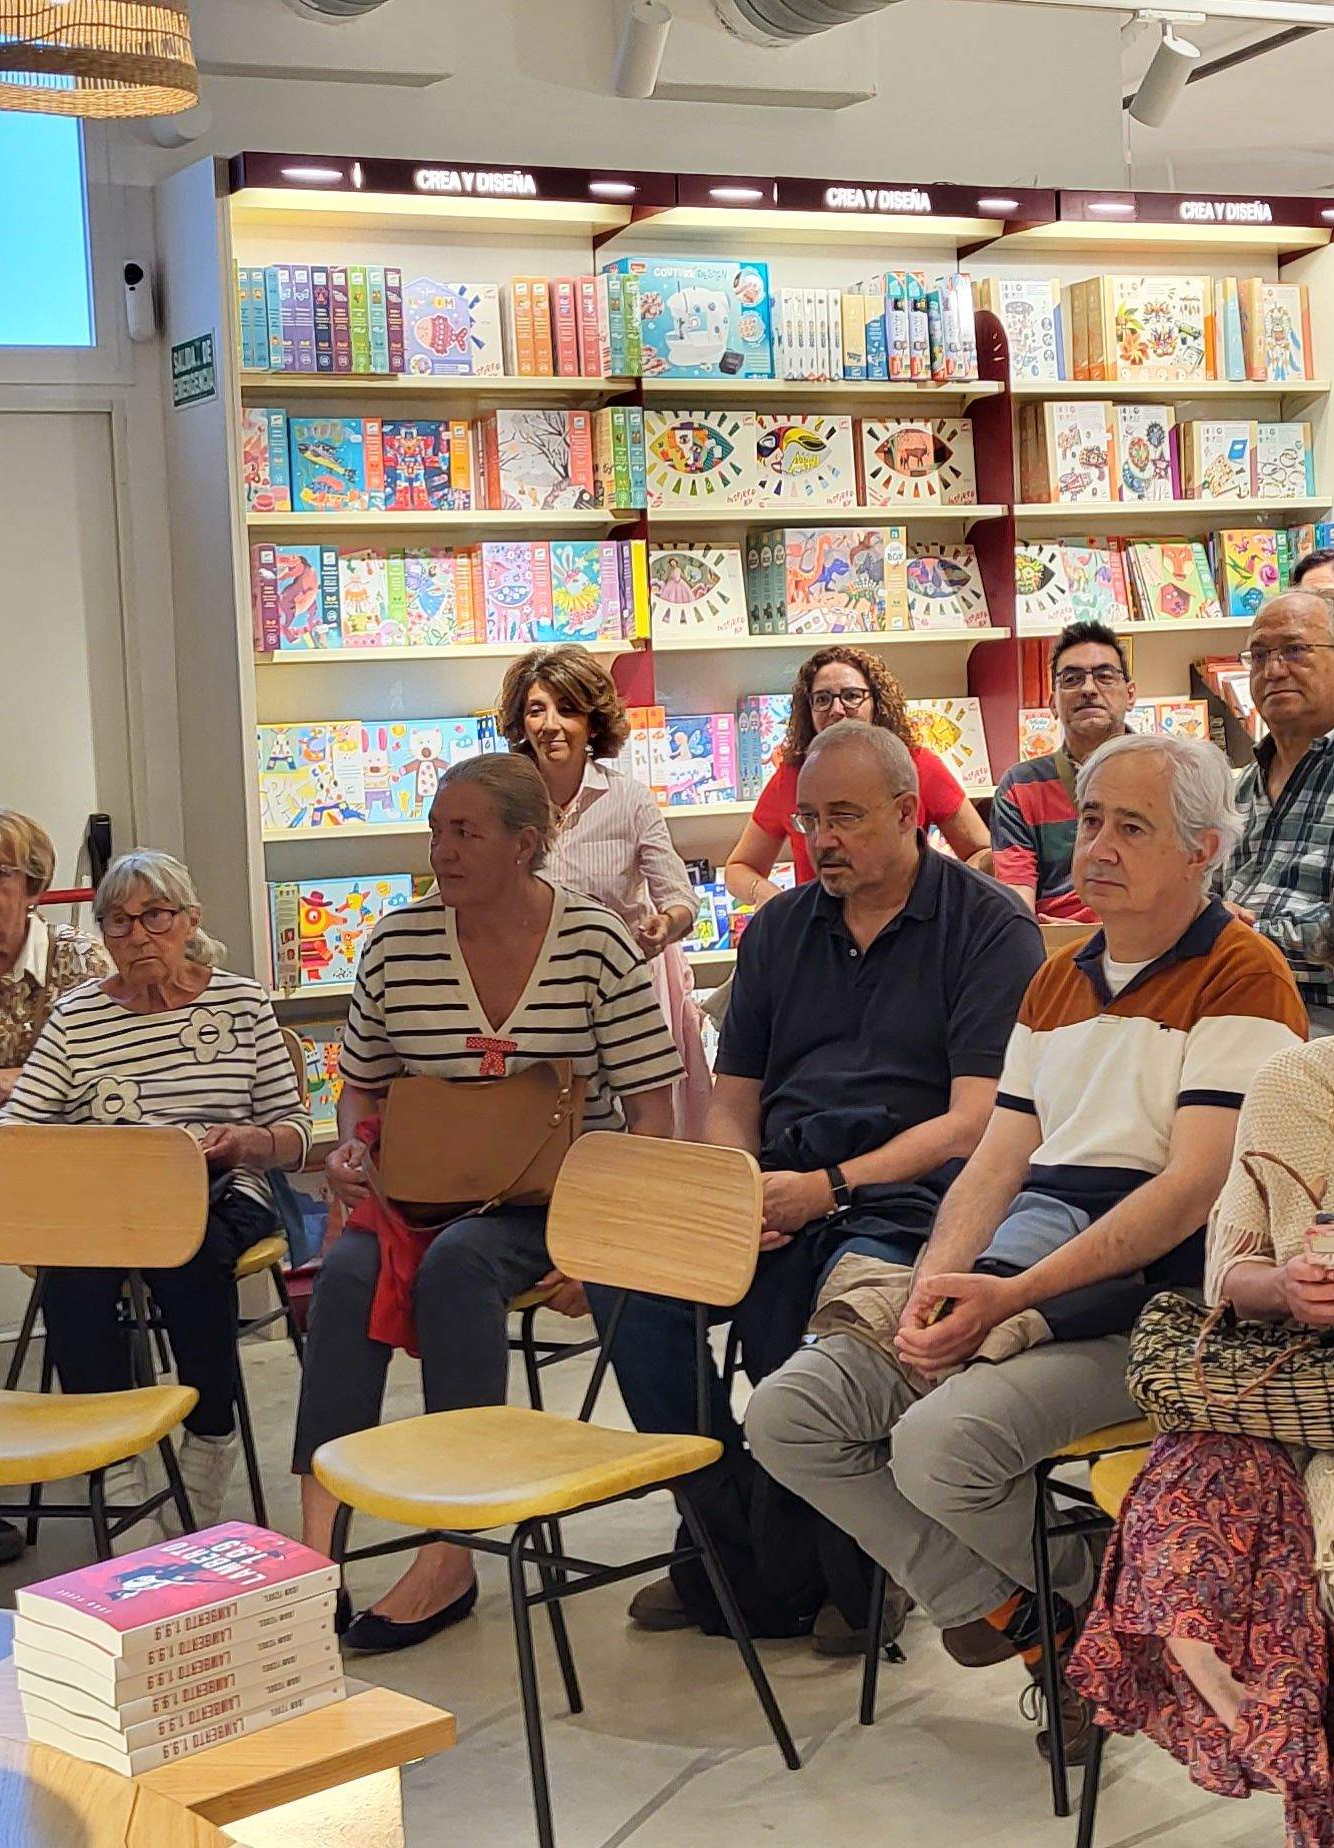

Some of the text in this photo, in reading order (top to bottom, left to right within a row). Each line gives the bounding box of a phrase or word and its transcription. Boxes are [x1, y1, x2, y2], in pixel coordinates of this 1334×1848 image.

[414, 169, 537, 193] CREA Y DISEÑA
[826, 187, 931, 211] CREA Y DISEÑA
[1179, 200, 1272, 221] CREA Y DISEÑA
[157, 1541, 266, 1585] LAMBERTO
[209, 1539, 268, 1564] 1.9.9
[185, 1602, 238, 1629] LAMBERTO
[178, 1626, 233, 1652] LAMBERTO
[178, 1651, 231, 1676] LAMBERTO
[182, 1673, 236, 1699] LAMBERTO
[188, 1695, 241, 1724] LAMBERTO
[192, 1717, 245, 1748] LAMBERTO
